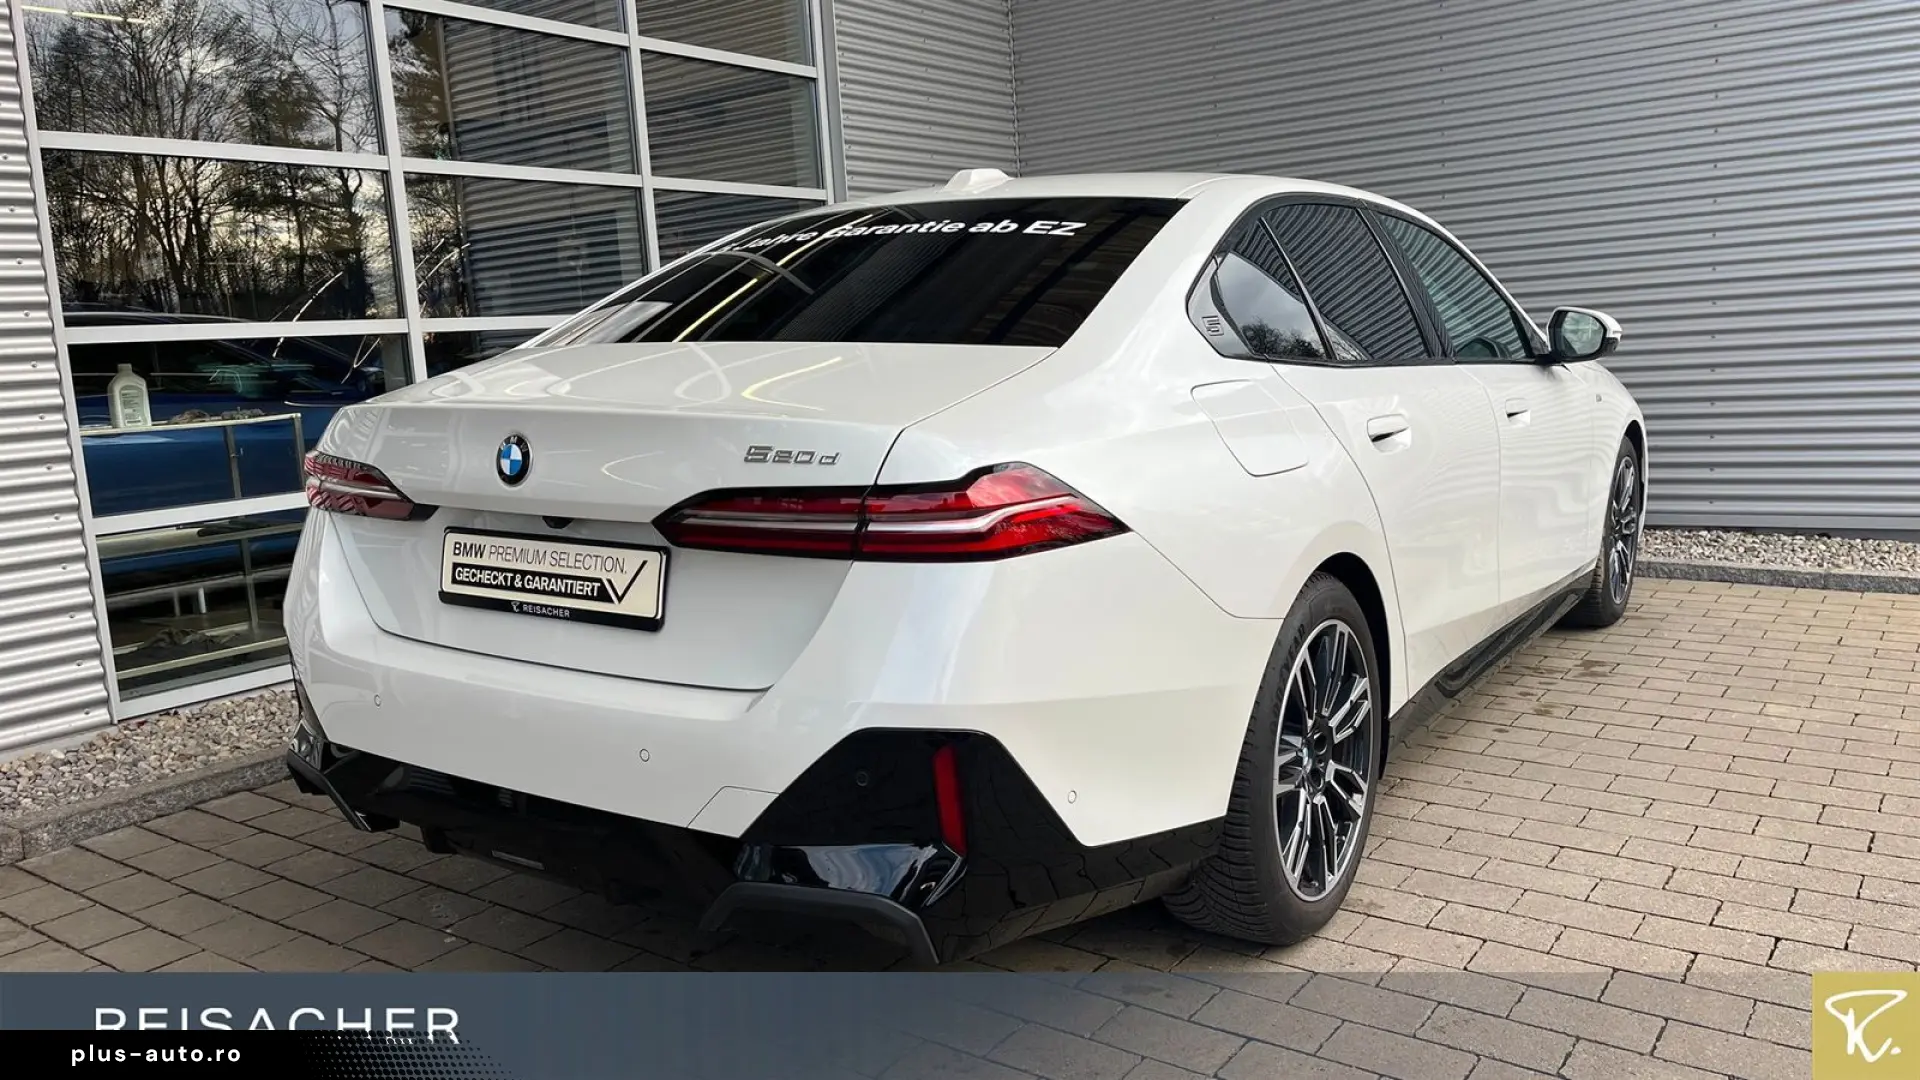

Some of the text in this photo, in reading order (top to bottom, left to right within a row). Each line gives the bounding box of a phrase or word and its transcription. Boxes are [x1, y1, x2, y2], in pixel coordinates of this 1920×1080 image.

[822, 219, 966, 238] Garantie
[968, 219, 1019, 233] ab
[1022, 220, 1087, 236] EZ
[453, 541, 627, 575] BMW PREMIUM SELECTION.
[455, 567, 601, 597] GECHECKT & GARANTIERT
[522, 604, 570, 618] REISACHER
